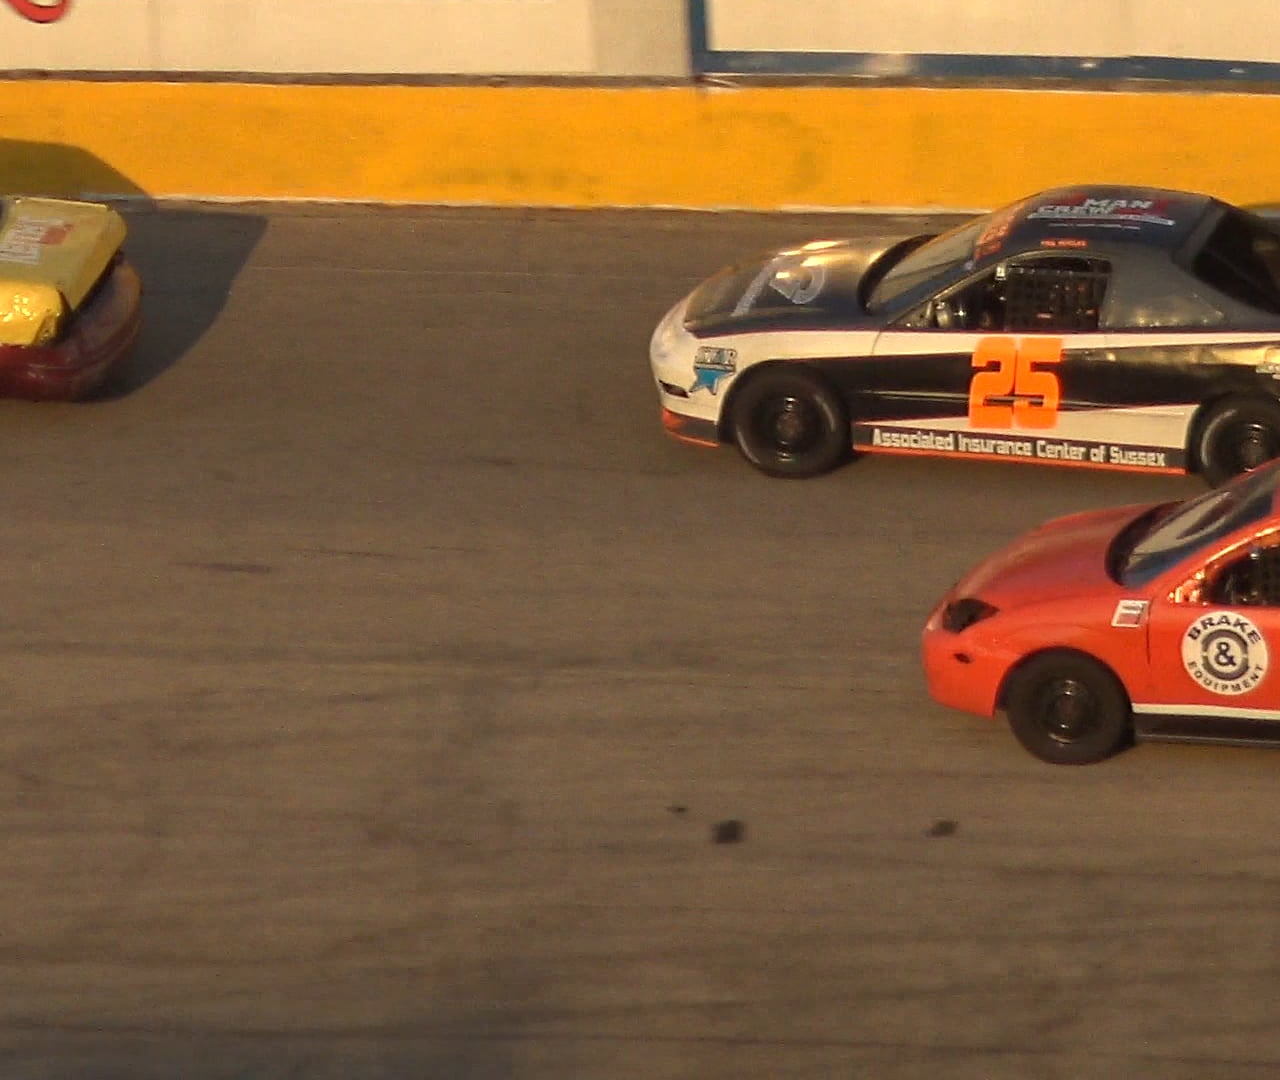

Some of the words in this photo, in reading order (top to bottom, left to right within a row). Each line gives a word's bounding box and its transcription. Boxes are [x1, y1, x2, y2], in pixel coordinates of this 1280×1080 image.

[968, 336, 1066, 429] 25
[872, 428, 955, 452] Associated
[957, 433, 1033, 457] Insurance
[1035, 440, 1085, 461] Center
[1089, 444, 1107, 463] of
[1109, 445, 1167, 467] Sussex
[1187, 614, 1262, 645] BRAKE
[1214, 641, 1237, 667] &
[1187, 660, 1264, 692] EQUIPMENT
